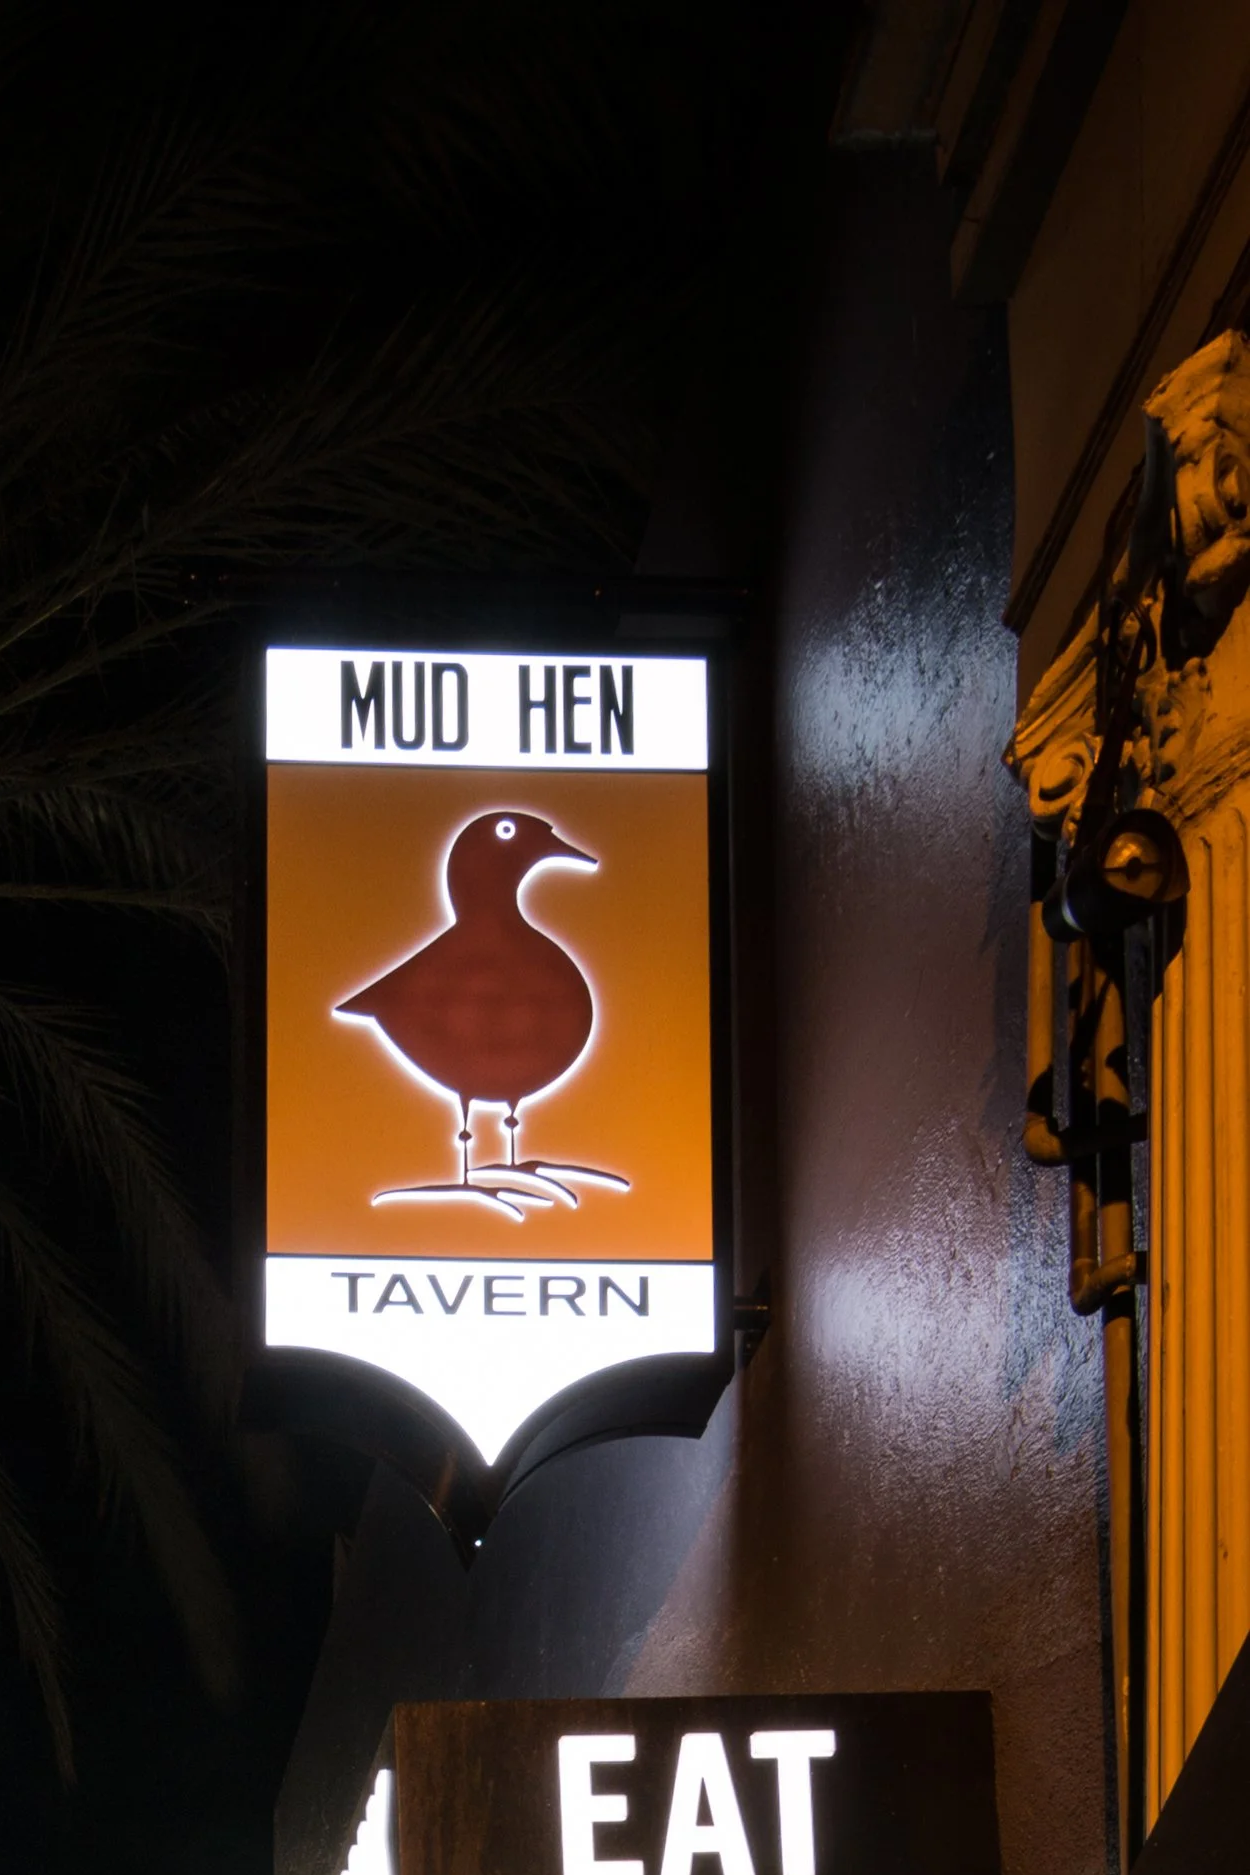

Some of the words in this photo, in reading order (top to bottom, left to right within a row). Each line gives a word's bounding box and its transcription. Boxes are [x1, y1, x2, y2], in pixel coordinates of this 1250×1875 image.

[340, 660, 469, 752] MUD
[518, 664, 635, 756] HEN
[331, 1271, 651, 1318] TAVERN
